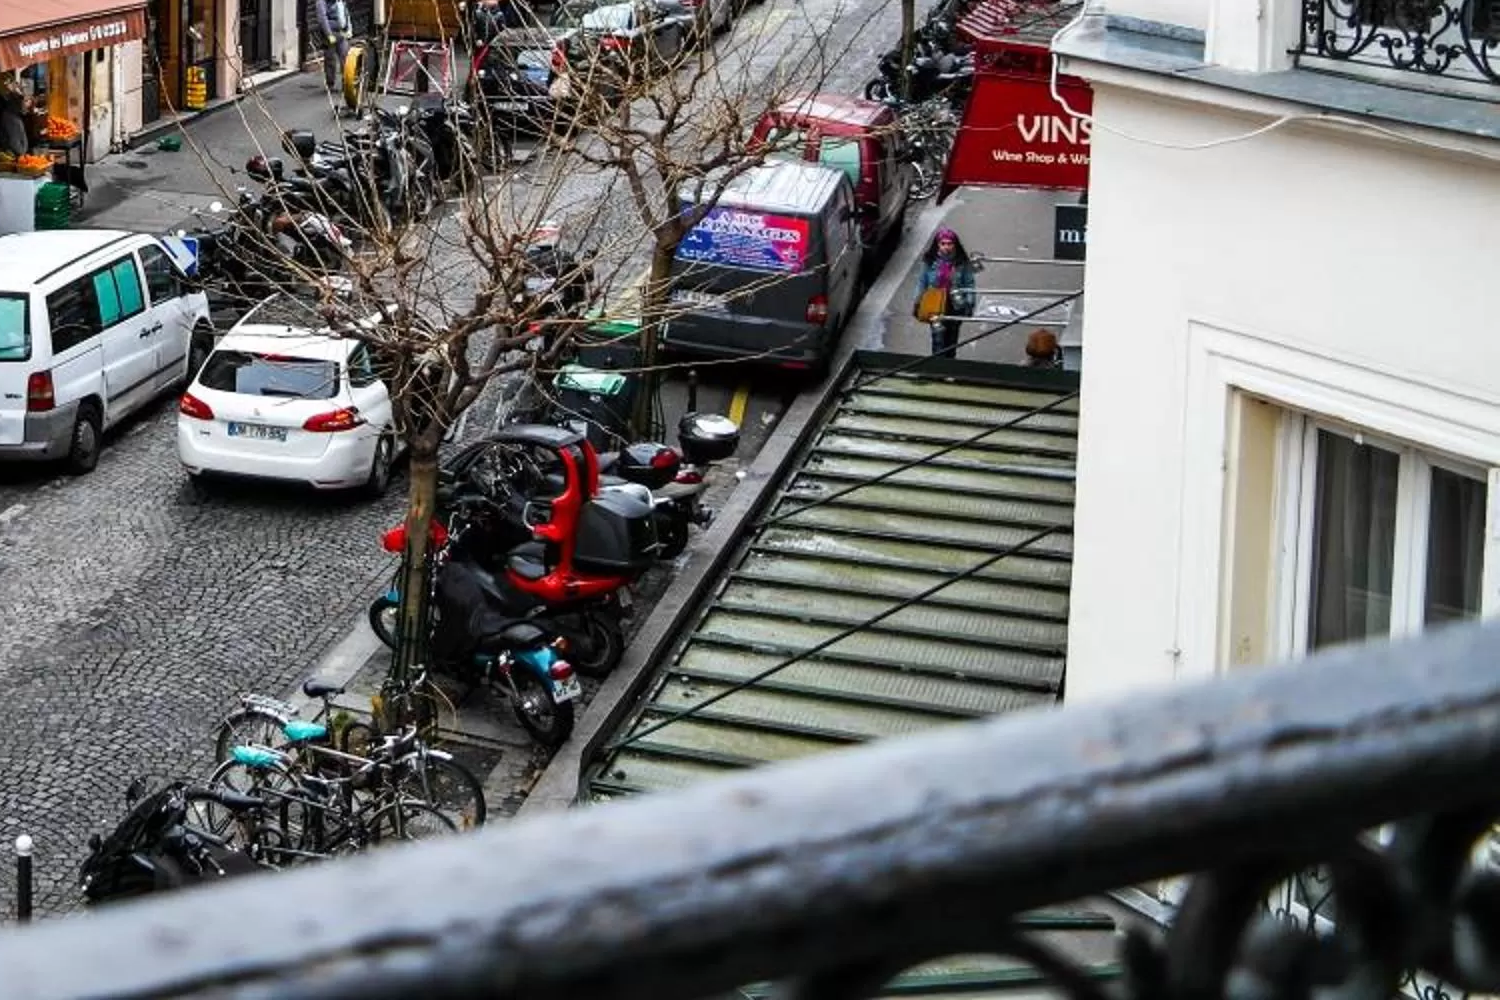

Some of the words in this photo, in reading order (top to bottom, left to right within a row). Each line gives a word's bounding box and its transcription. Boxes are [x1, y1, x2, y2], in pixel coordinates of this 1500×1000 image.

[1017, 113, 1092, 145] VINS
[991, 149, 1024, 163] Wine
[1025, 151, 1055, 165] Shop
[1057, 153, 1069, 165] &
